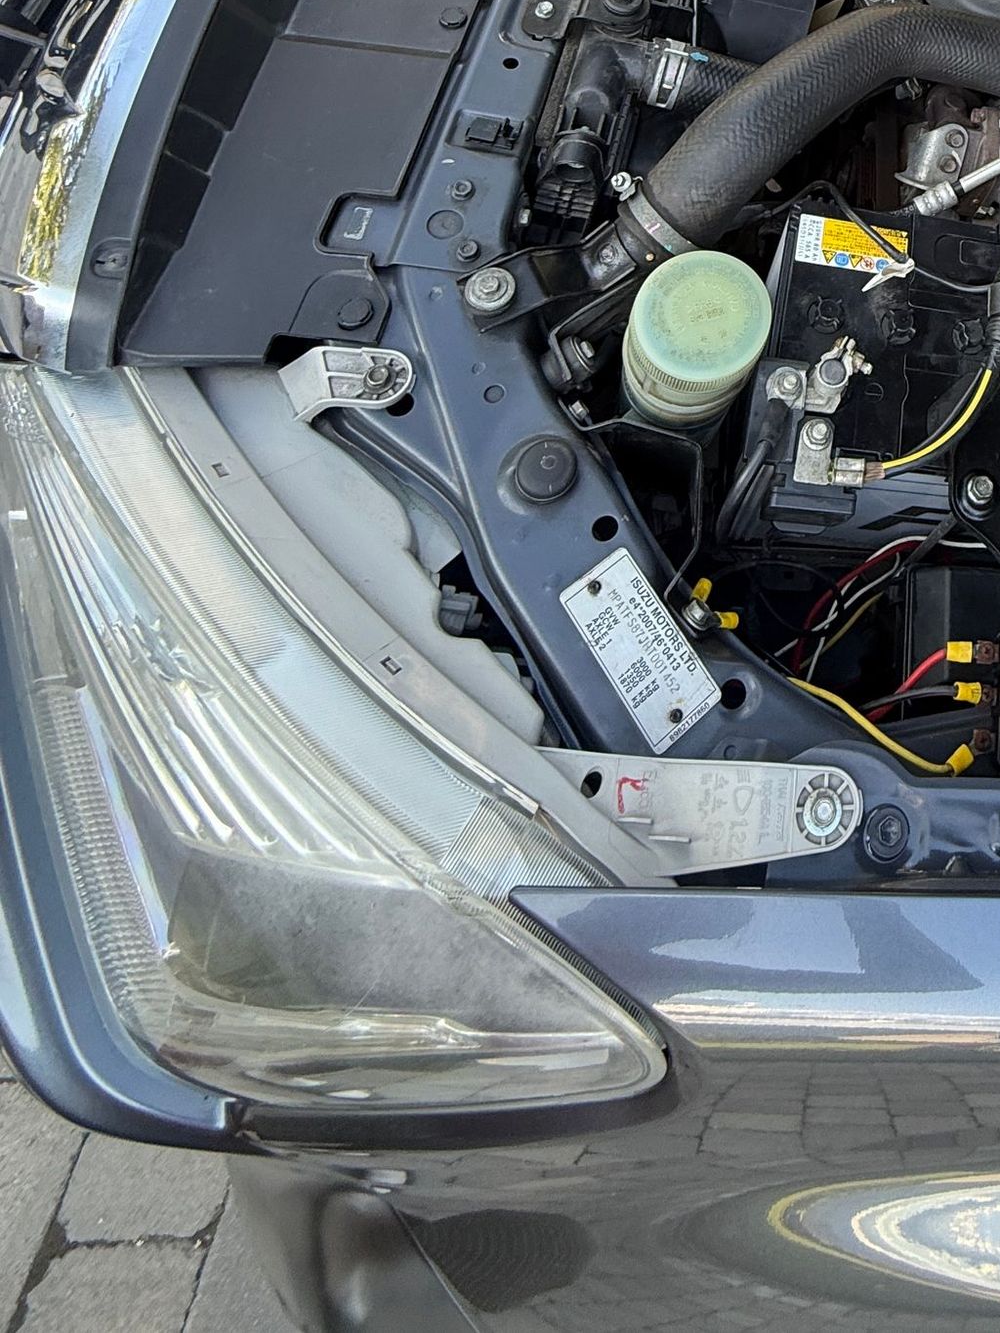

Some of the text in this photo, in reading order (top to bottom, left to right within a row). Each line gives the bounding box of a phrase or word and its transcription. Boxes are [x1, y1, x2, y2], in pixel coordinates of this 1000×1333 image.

[584, 622, 642, 709] AXLE 2 1870 kg
[590, 616, 649, 703] AXLE 1 1350 kg
[596, 610, 655, 697] GCW 6000 kg
[603, 605, 661, 692] GVW 3000 kg
[629, 576, 699, 676] ISUZU MOTORS LTD.
